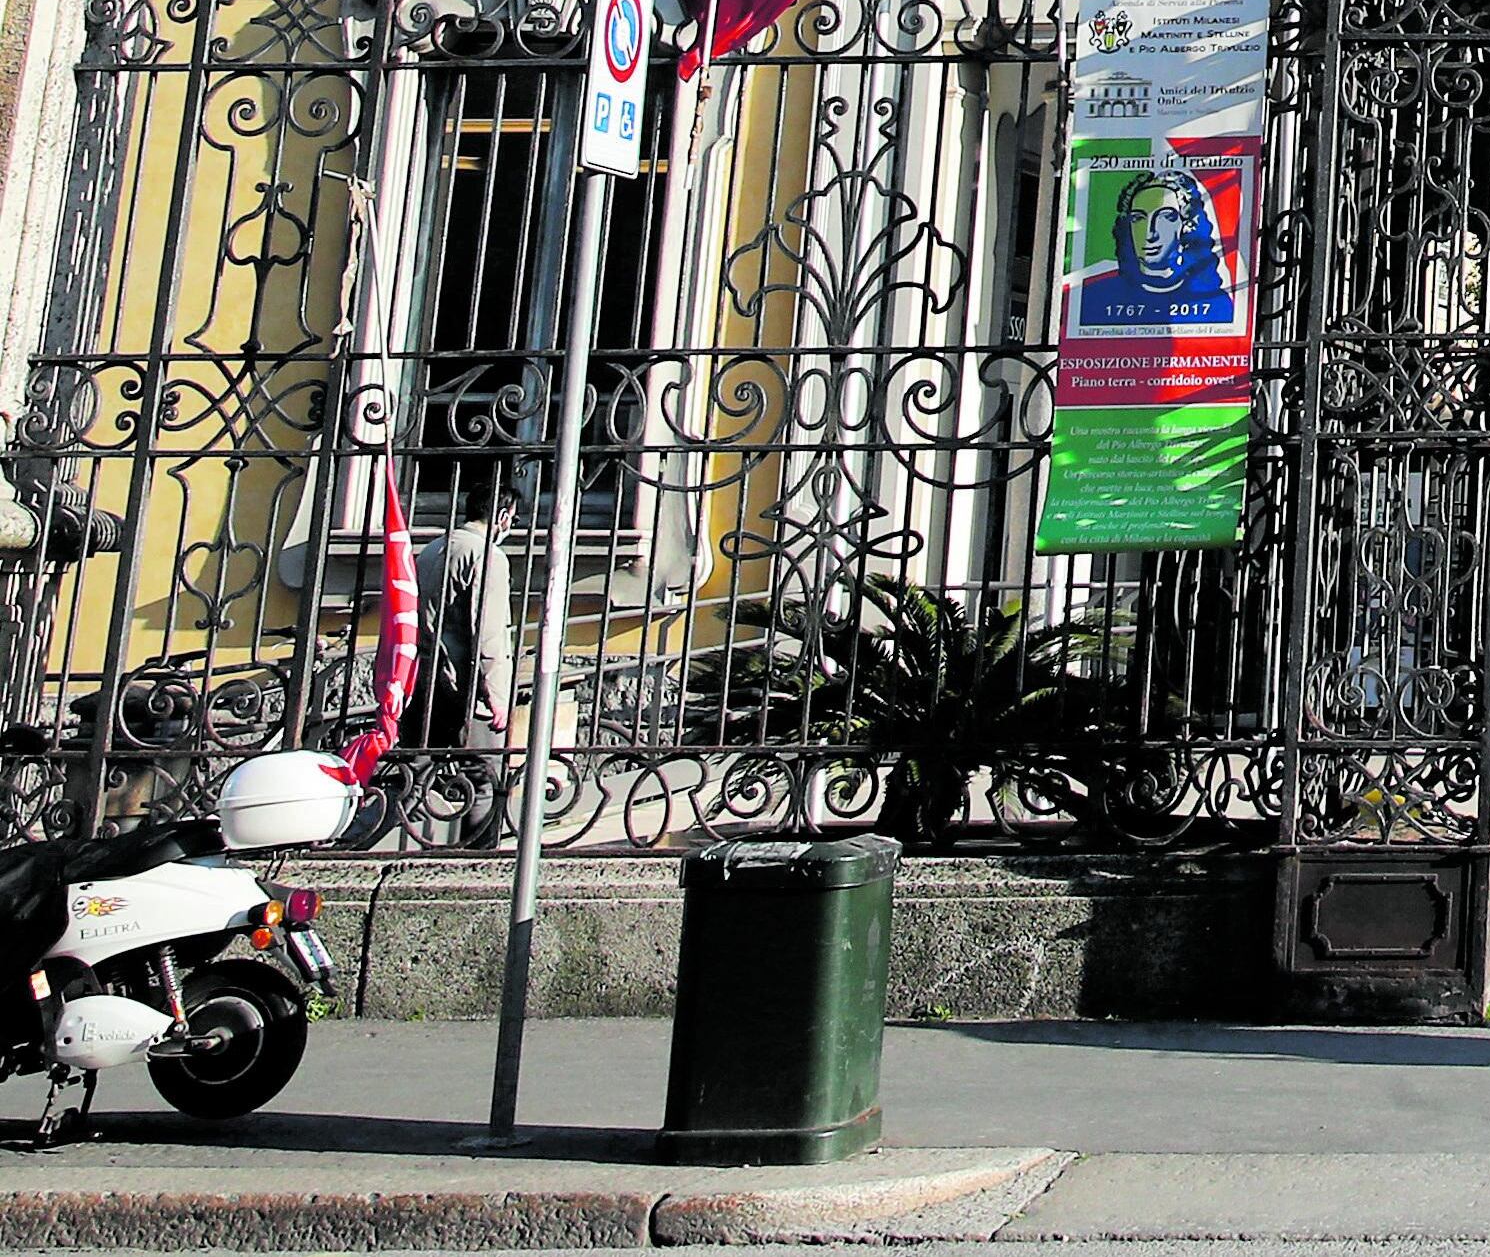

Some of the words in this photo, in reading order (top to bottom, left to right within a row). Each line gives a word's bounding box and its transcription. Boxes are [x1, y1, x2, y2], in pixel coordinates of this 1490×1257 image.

[596, 97, 610, 128] P
[1090, 155, 1118, 169] 250
[1123, 155, 1155, 169] anni
[1160, 154, 1174, 168] di
[1181, 155, 1244, 168] Trivulzio
[1106, 304, 1146, 317] 1767
[1169, 303, 1211, 316] 2017
[1060, 356, 1149, 369] ESPOSIZIONE
[1153, 355, 1248, 368] PERMANENTE
[1072, 375, 1105, 387] Piano
[1108, 375, 1136, 387] terra
[1147, 374, 1202, 386] corridoio
